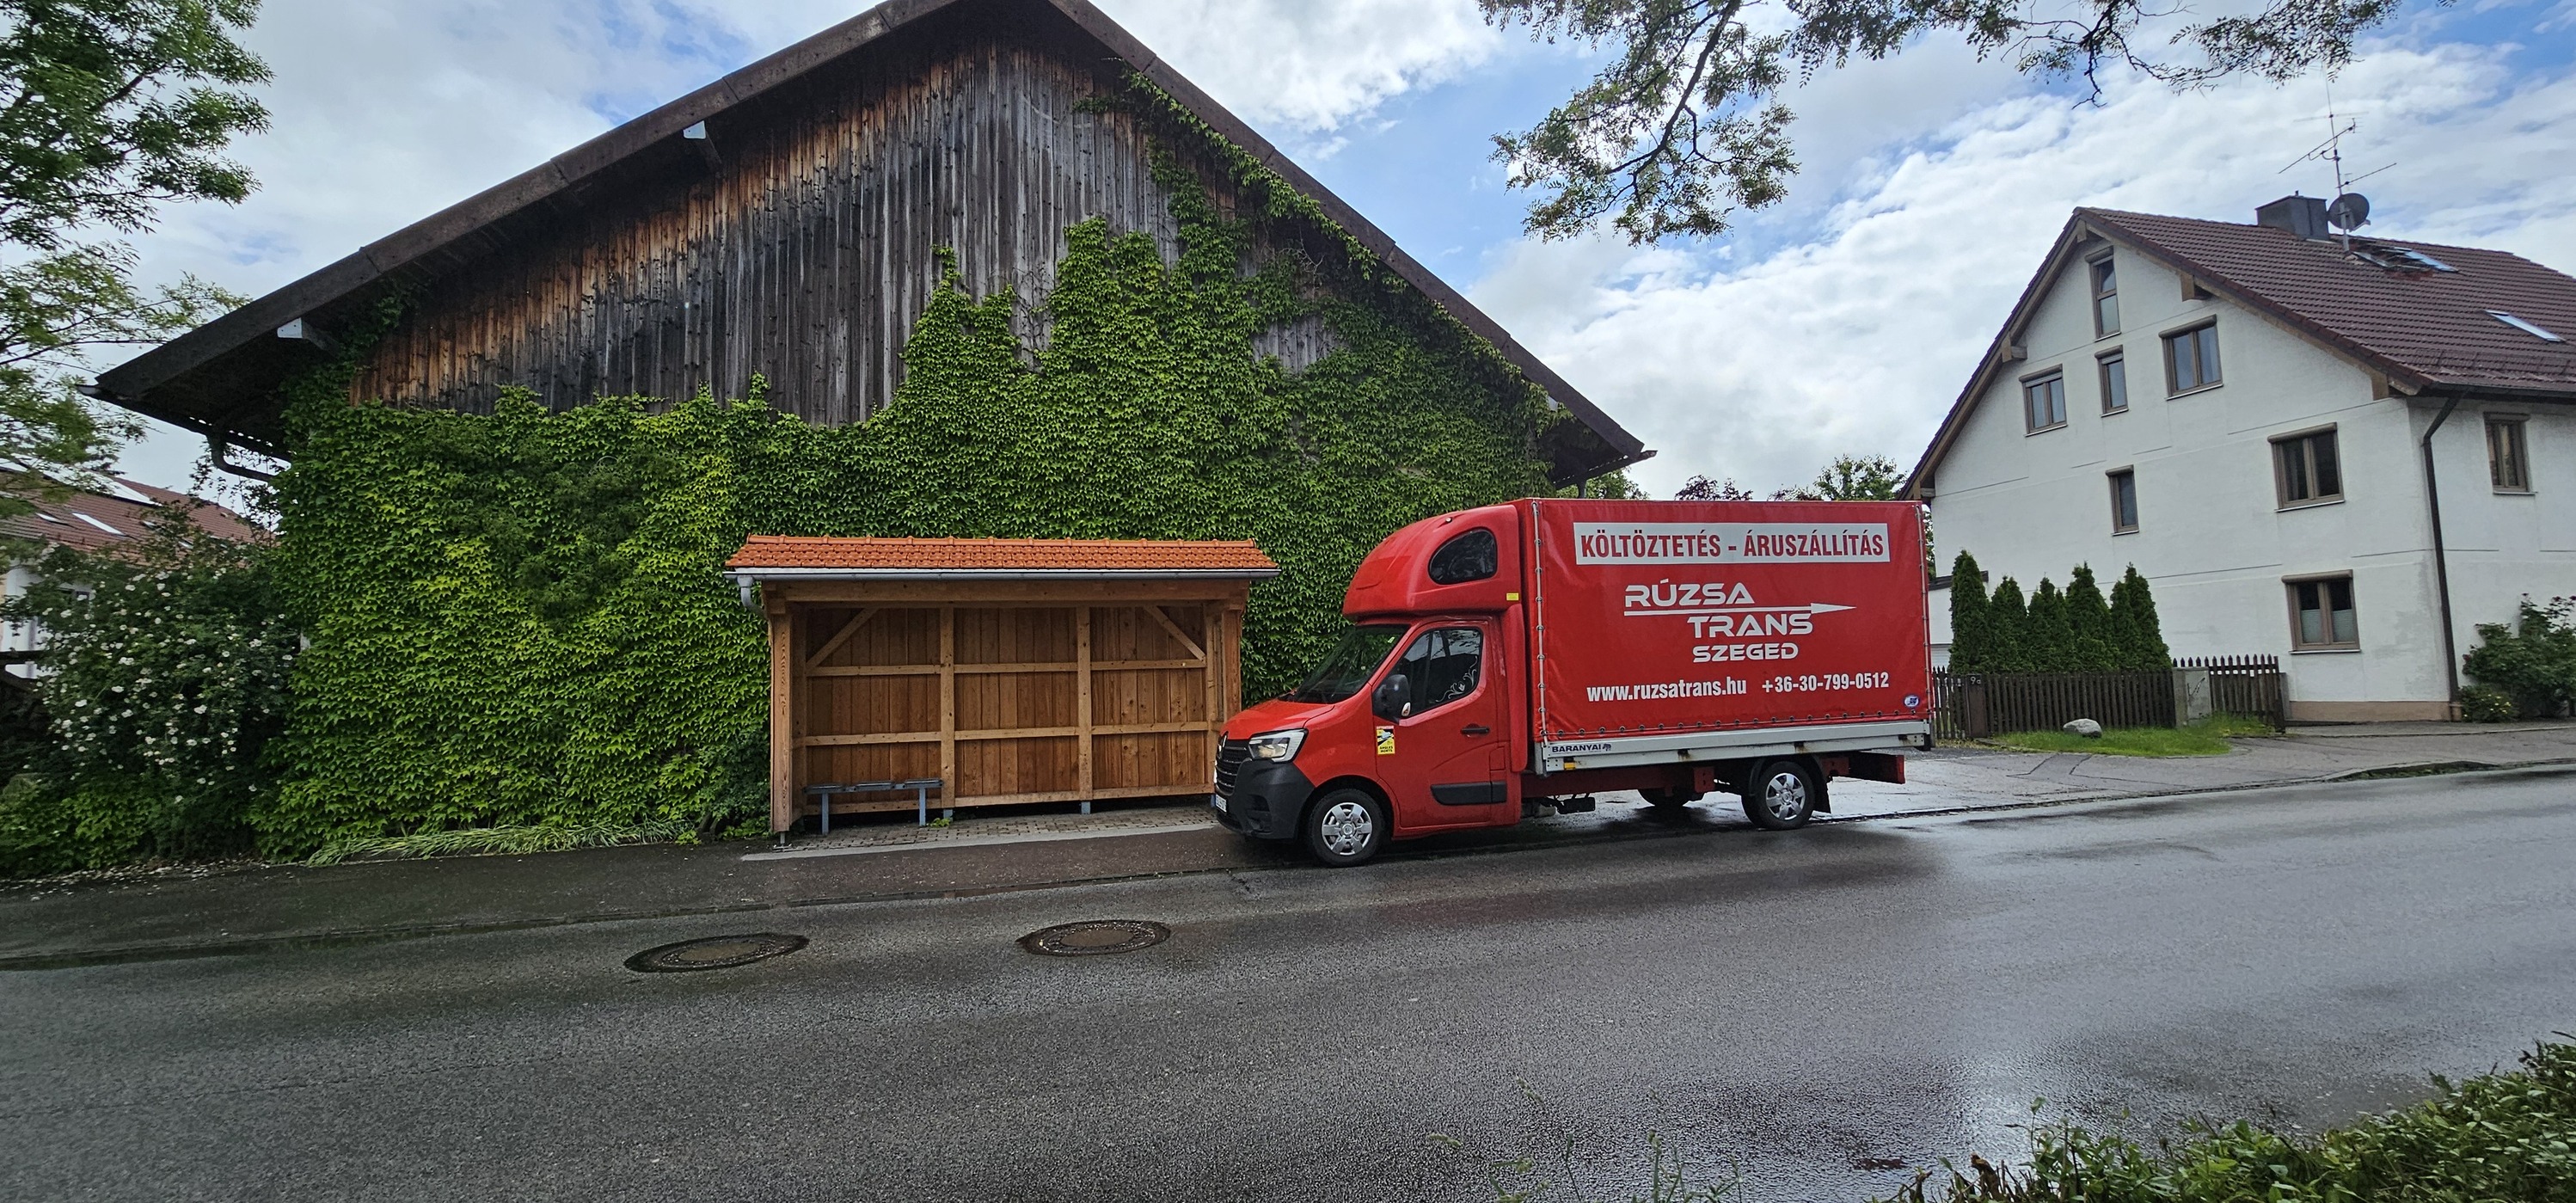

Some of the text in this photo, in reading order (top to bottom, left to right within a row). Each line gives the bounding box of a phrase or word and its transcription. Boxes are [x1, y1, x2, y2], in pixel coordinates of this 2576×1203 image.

[1580, 529, 1721, 557] KÖLTÖZTETÉS
[1743, 529, 1884, 557] ÁRUSZÁLLÍTÁS
[1625, 578, 1755, 607] RÚZSA
[1687, 613, 1813, 638] TRANS
[1692, 642, 1799, 663] SZEGED
[1586, 672, 1889, 702] www.ruzsatrans.hu +36-30-799-0512
[1970, 676, 1982, 684] 9a
[1551, 744, 1602, 753] BARANYAI
